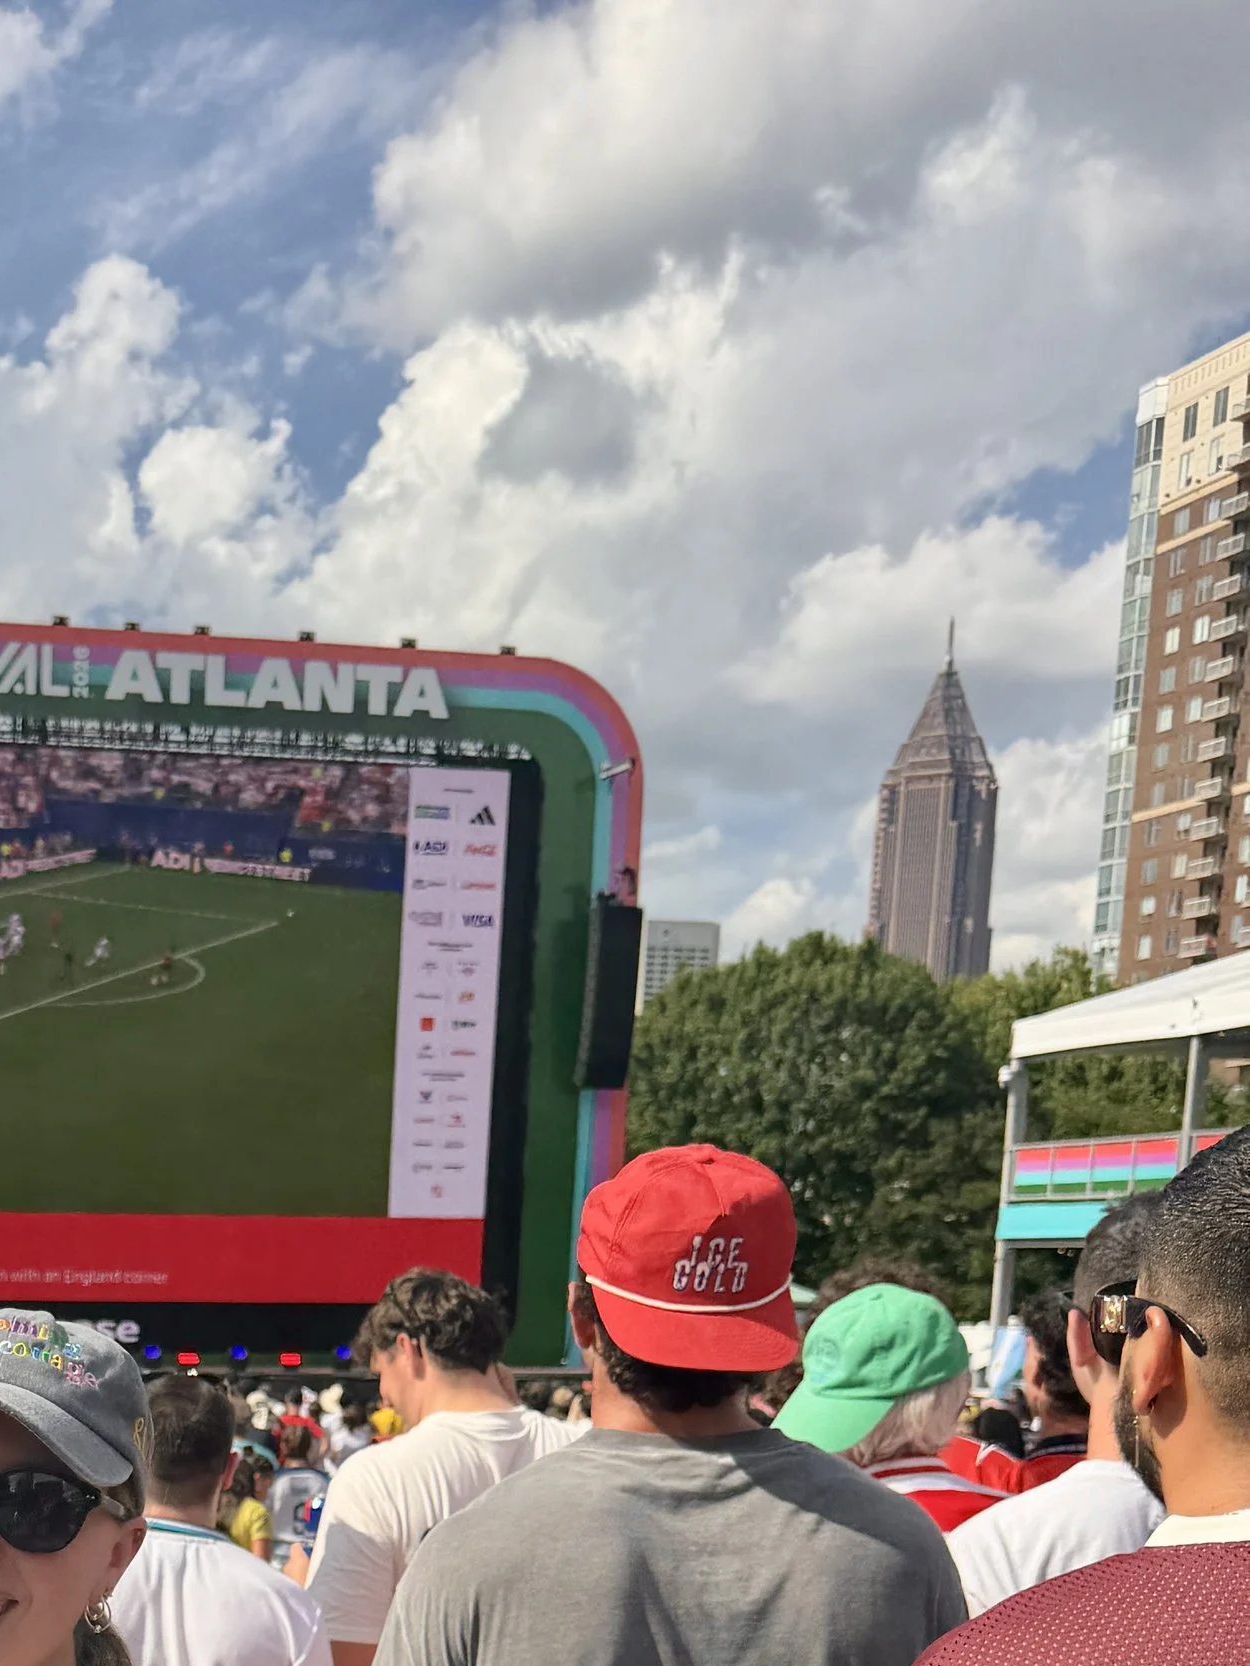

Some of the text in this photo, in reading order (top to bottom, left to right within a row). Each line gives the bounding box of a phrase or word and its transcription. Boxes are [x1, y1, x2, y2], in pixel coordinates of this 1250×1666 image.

[104, 649, 450, 719] ATLANTA
[690, 1235, 744, 1269] ICE
[63, 1269, 123, 1287] England
[673, 1259, 748, 1293] COLD
